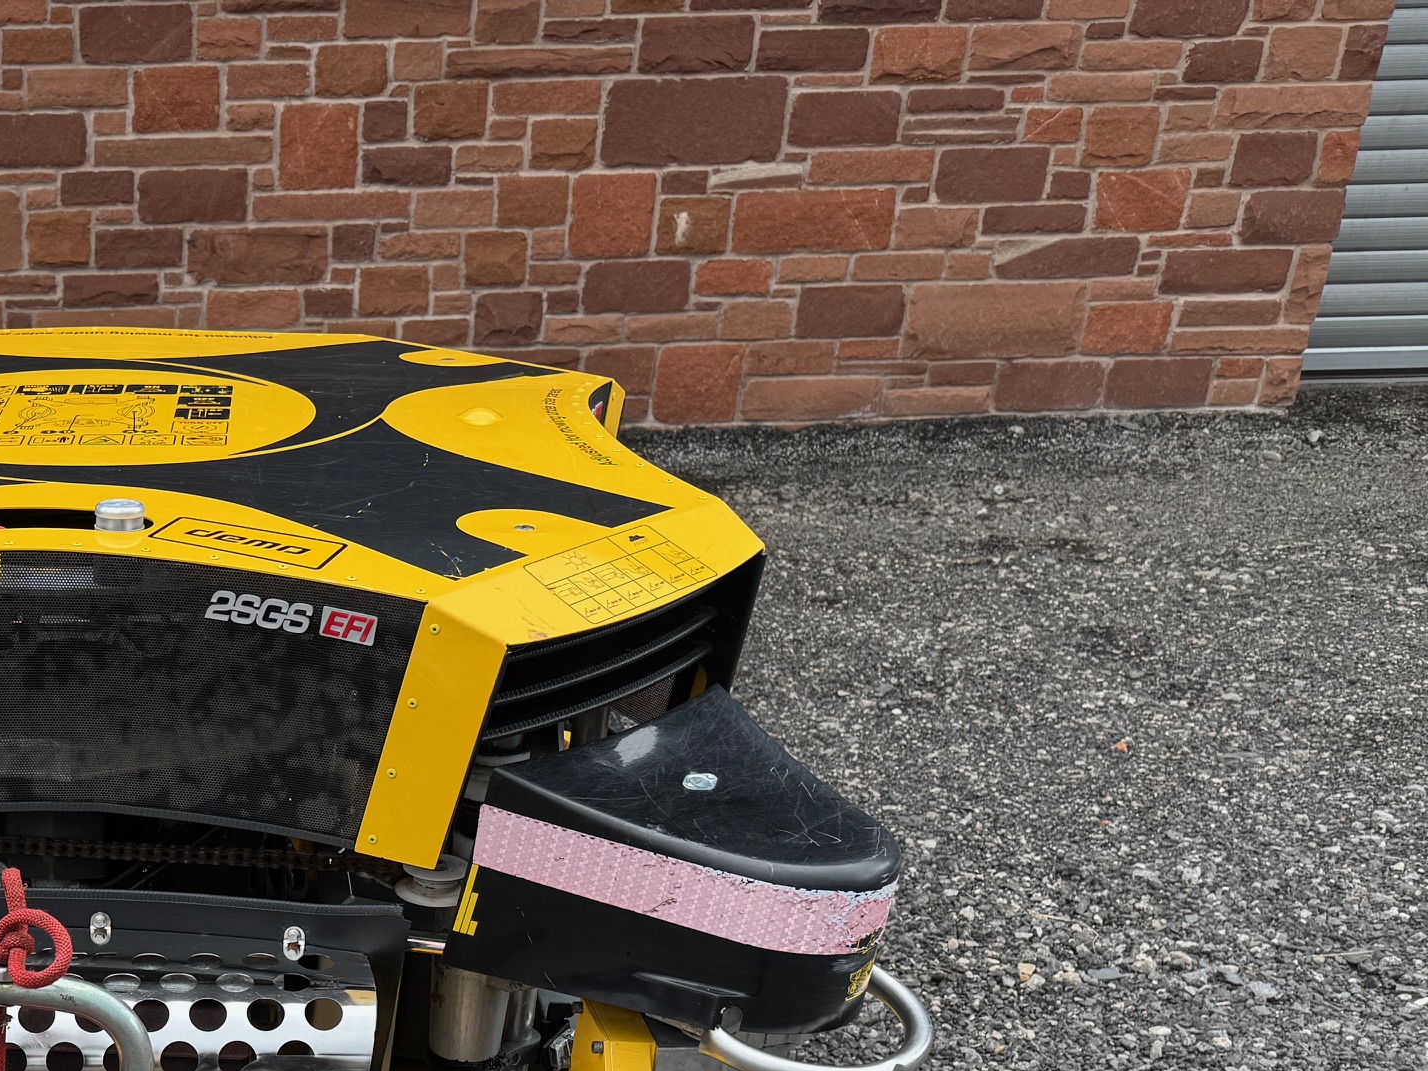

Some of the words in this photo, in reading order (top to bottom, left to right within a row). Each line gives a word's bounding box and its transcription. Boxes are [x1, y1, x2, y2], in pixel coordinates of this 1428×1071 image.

[184, 528, 312, 556] demo
[204, 589, 314, 634] 2SGS
[321, 610, 375, 643] EFI
